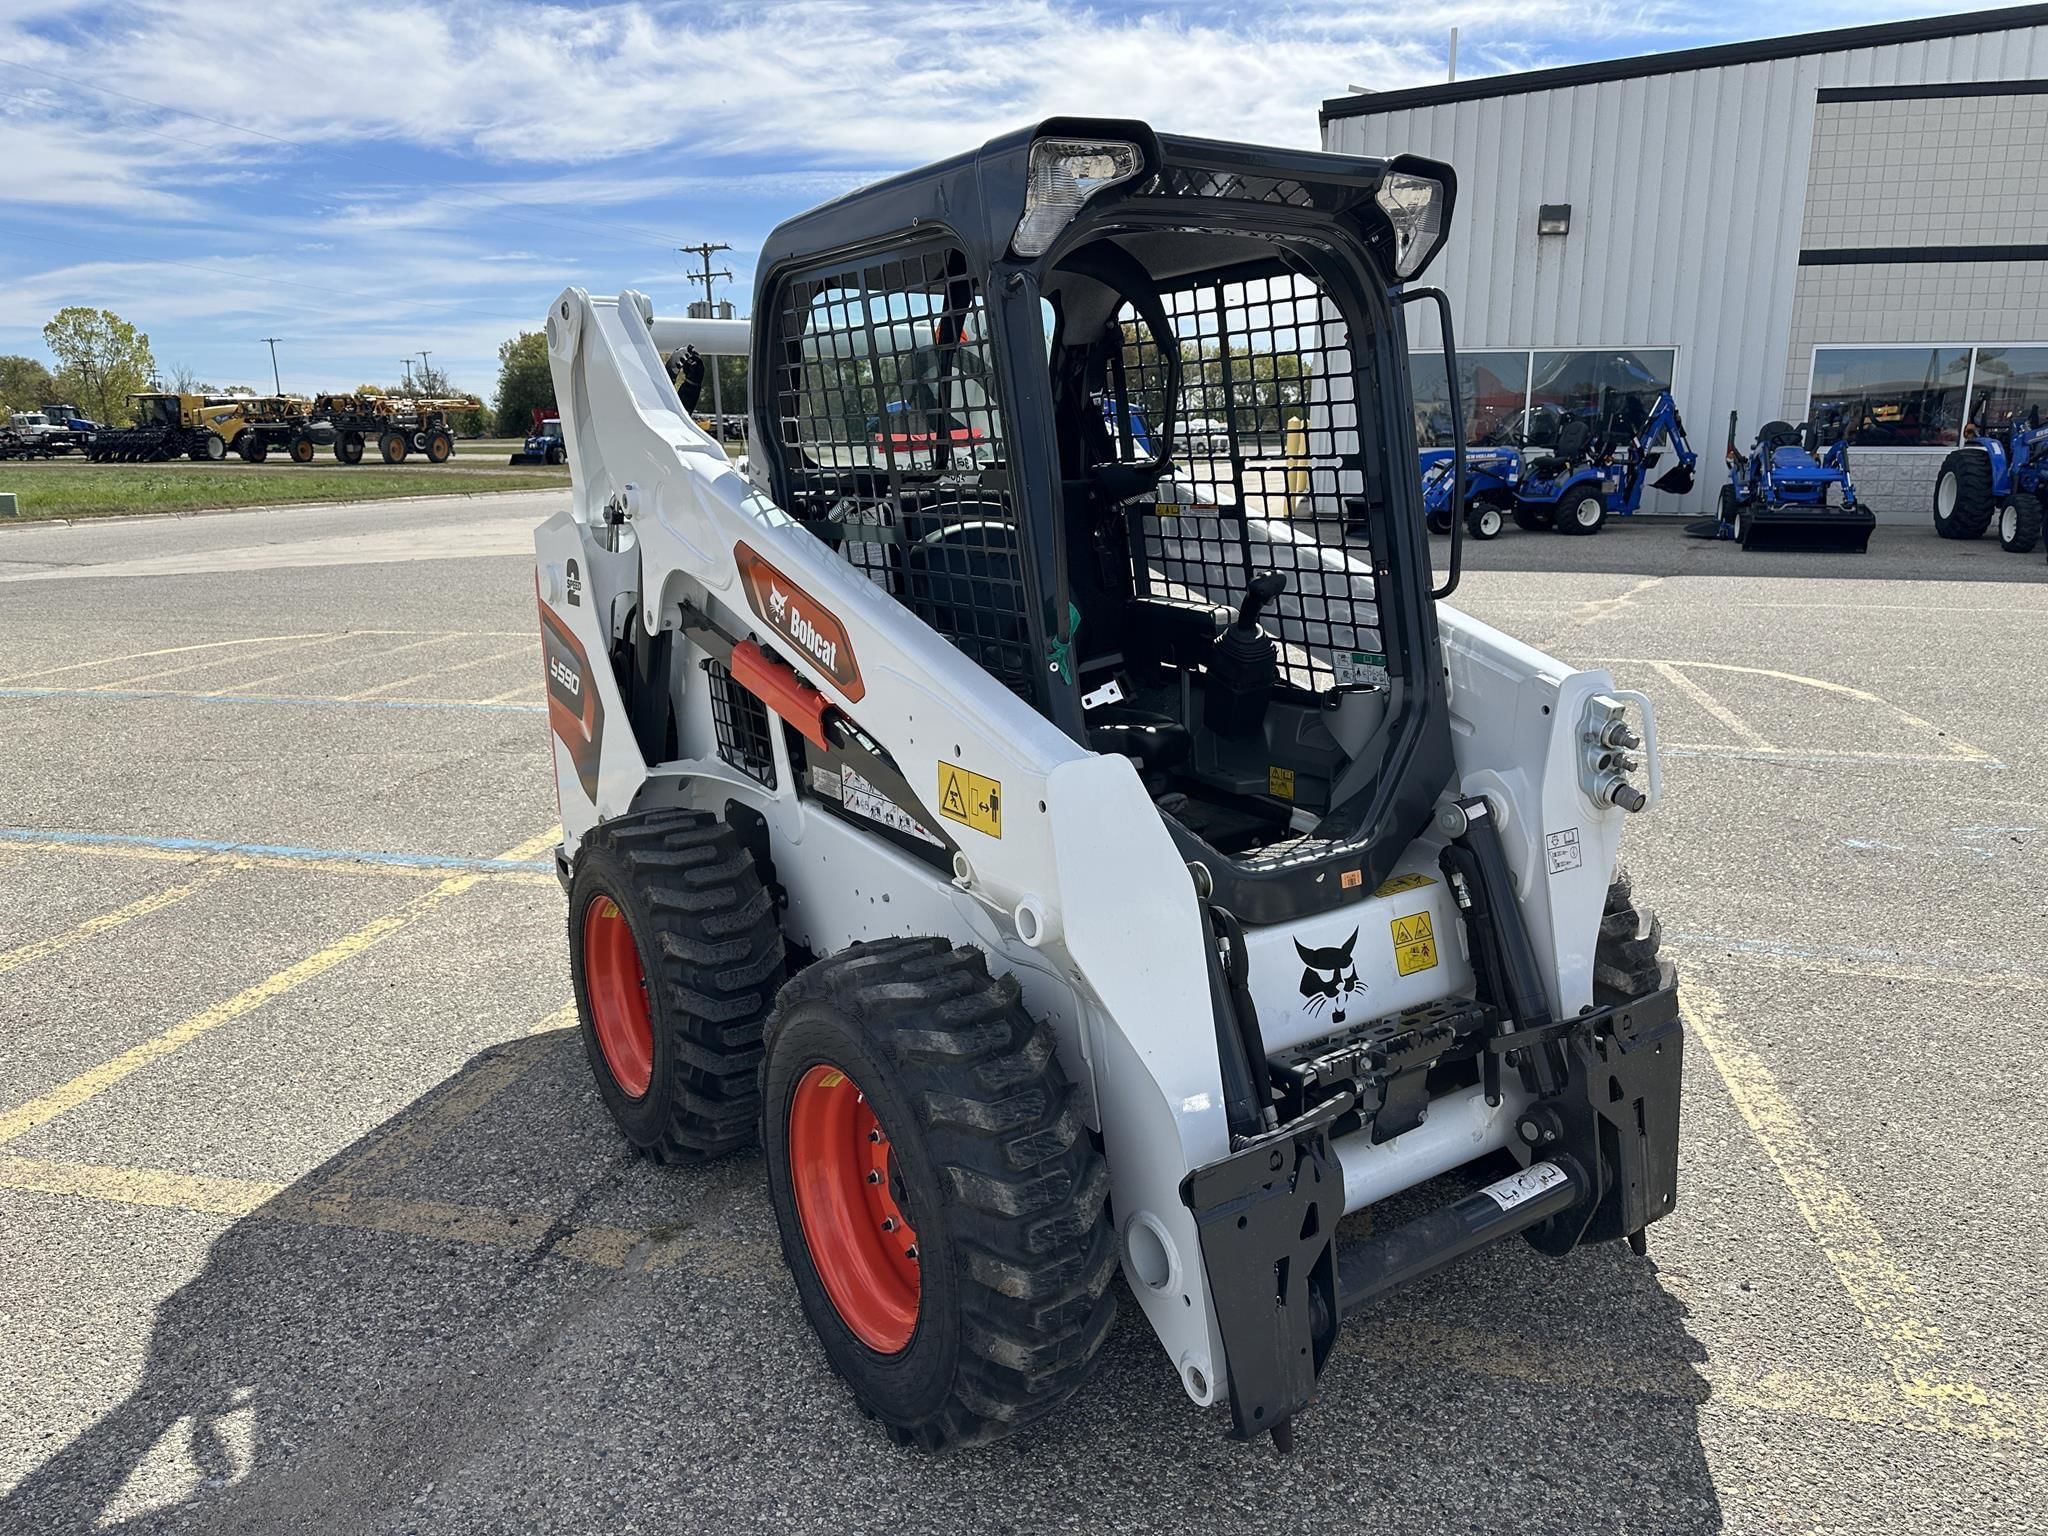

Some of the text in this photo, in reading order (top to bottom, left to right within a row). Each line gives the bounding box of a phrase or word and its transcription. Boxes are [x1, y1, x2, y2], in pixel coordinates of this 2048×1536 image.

[567, 579, 581, 591] SPEED
[791, 606, 836, 672] Bobcat
[550, 656, 580, 696] S590
